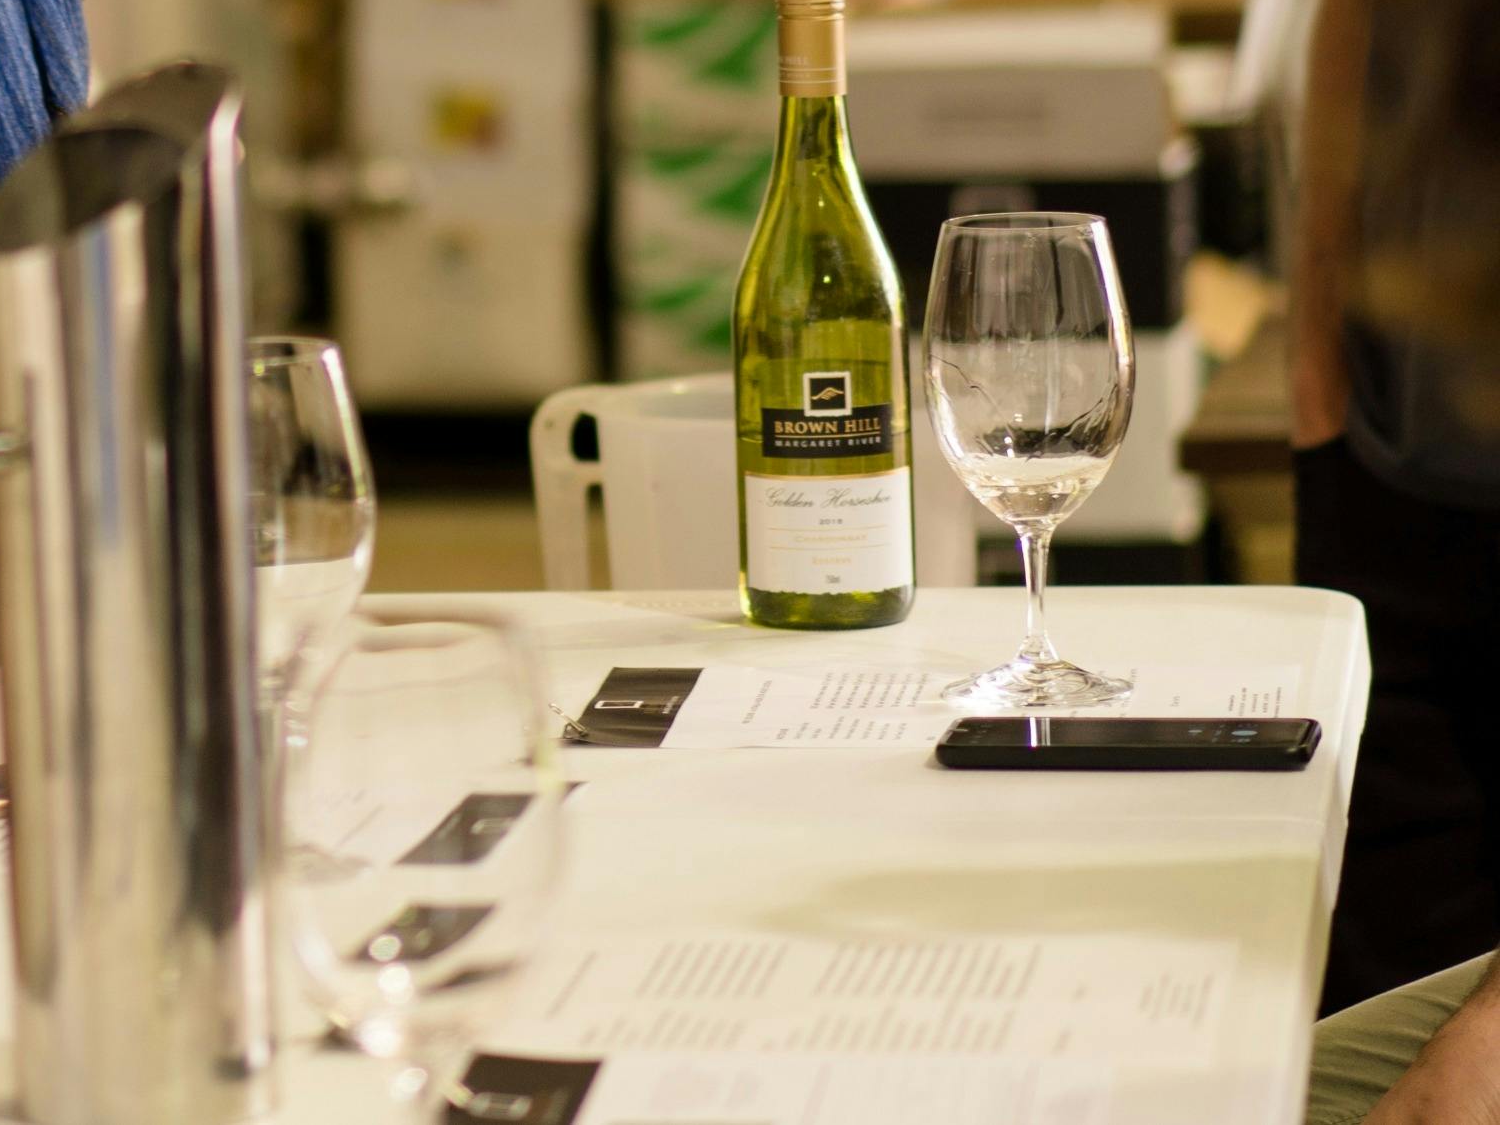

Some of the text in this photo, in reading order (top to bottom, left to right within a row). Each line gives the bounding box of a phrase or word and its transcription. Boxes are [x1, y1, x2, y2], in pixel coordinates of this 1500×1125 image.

[775, 417, 881, 434] BROWN HILL
[775, 437, 881, 448] MARGARET RIVER
[765, 487, 815, 507] Golden
